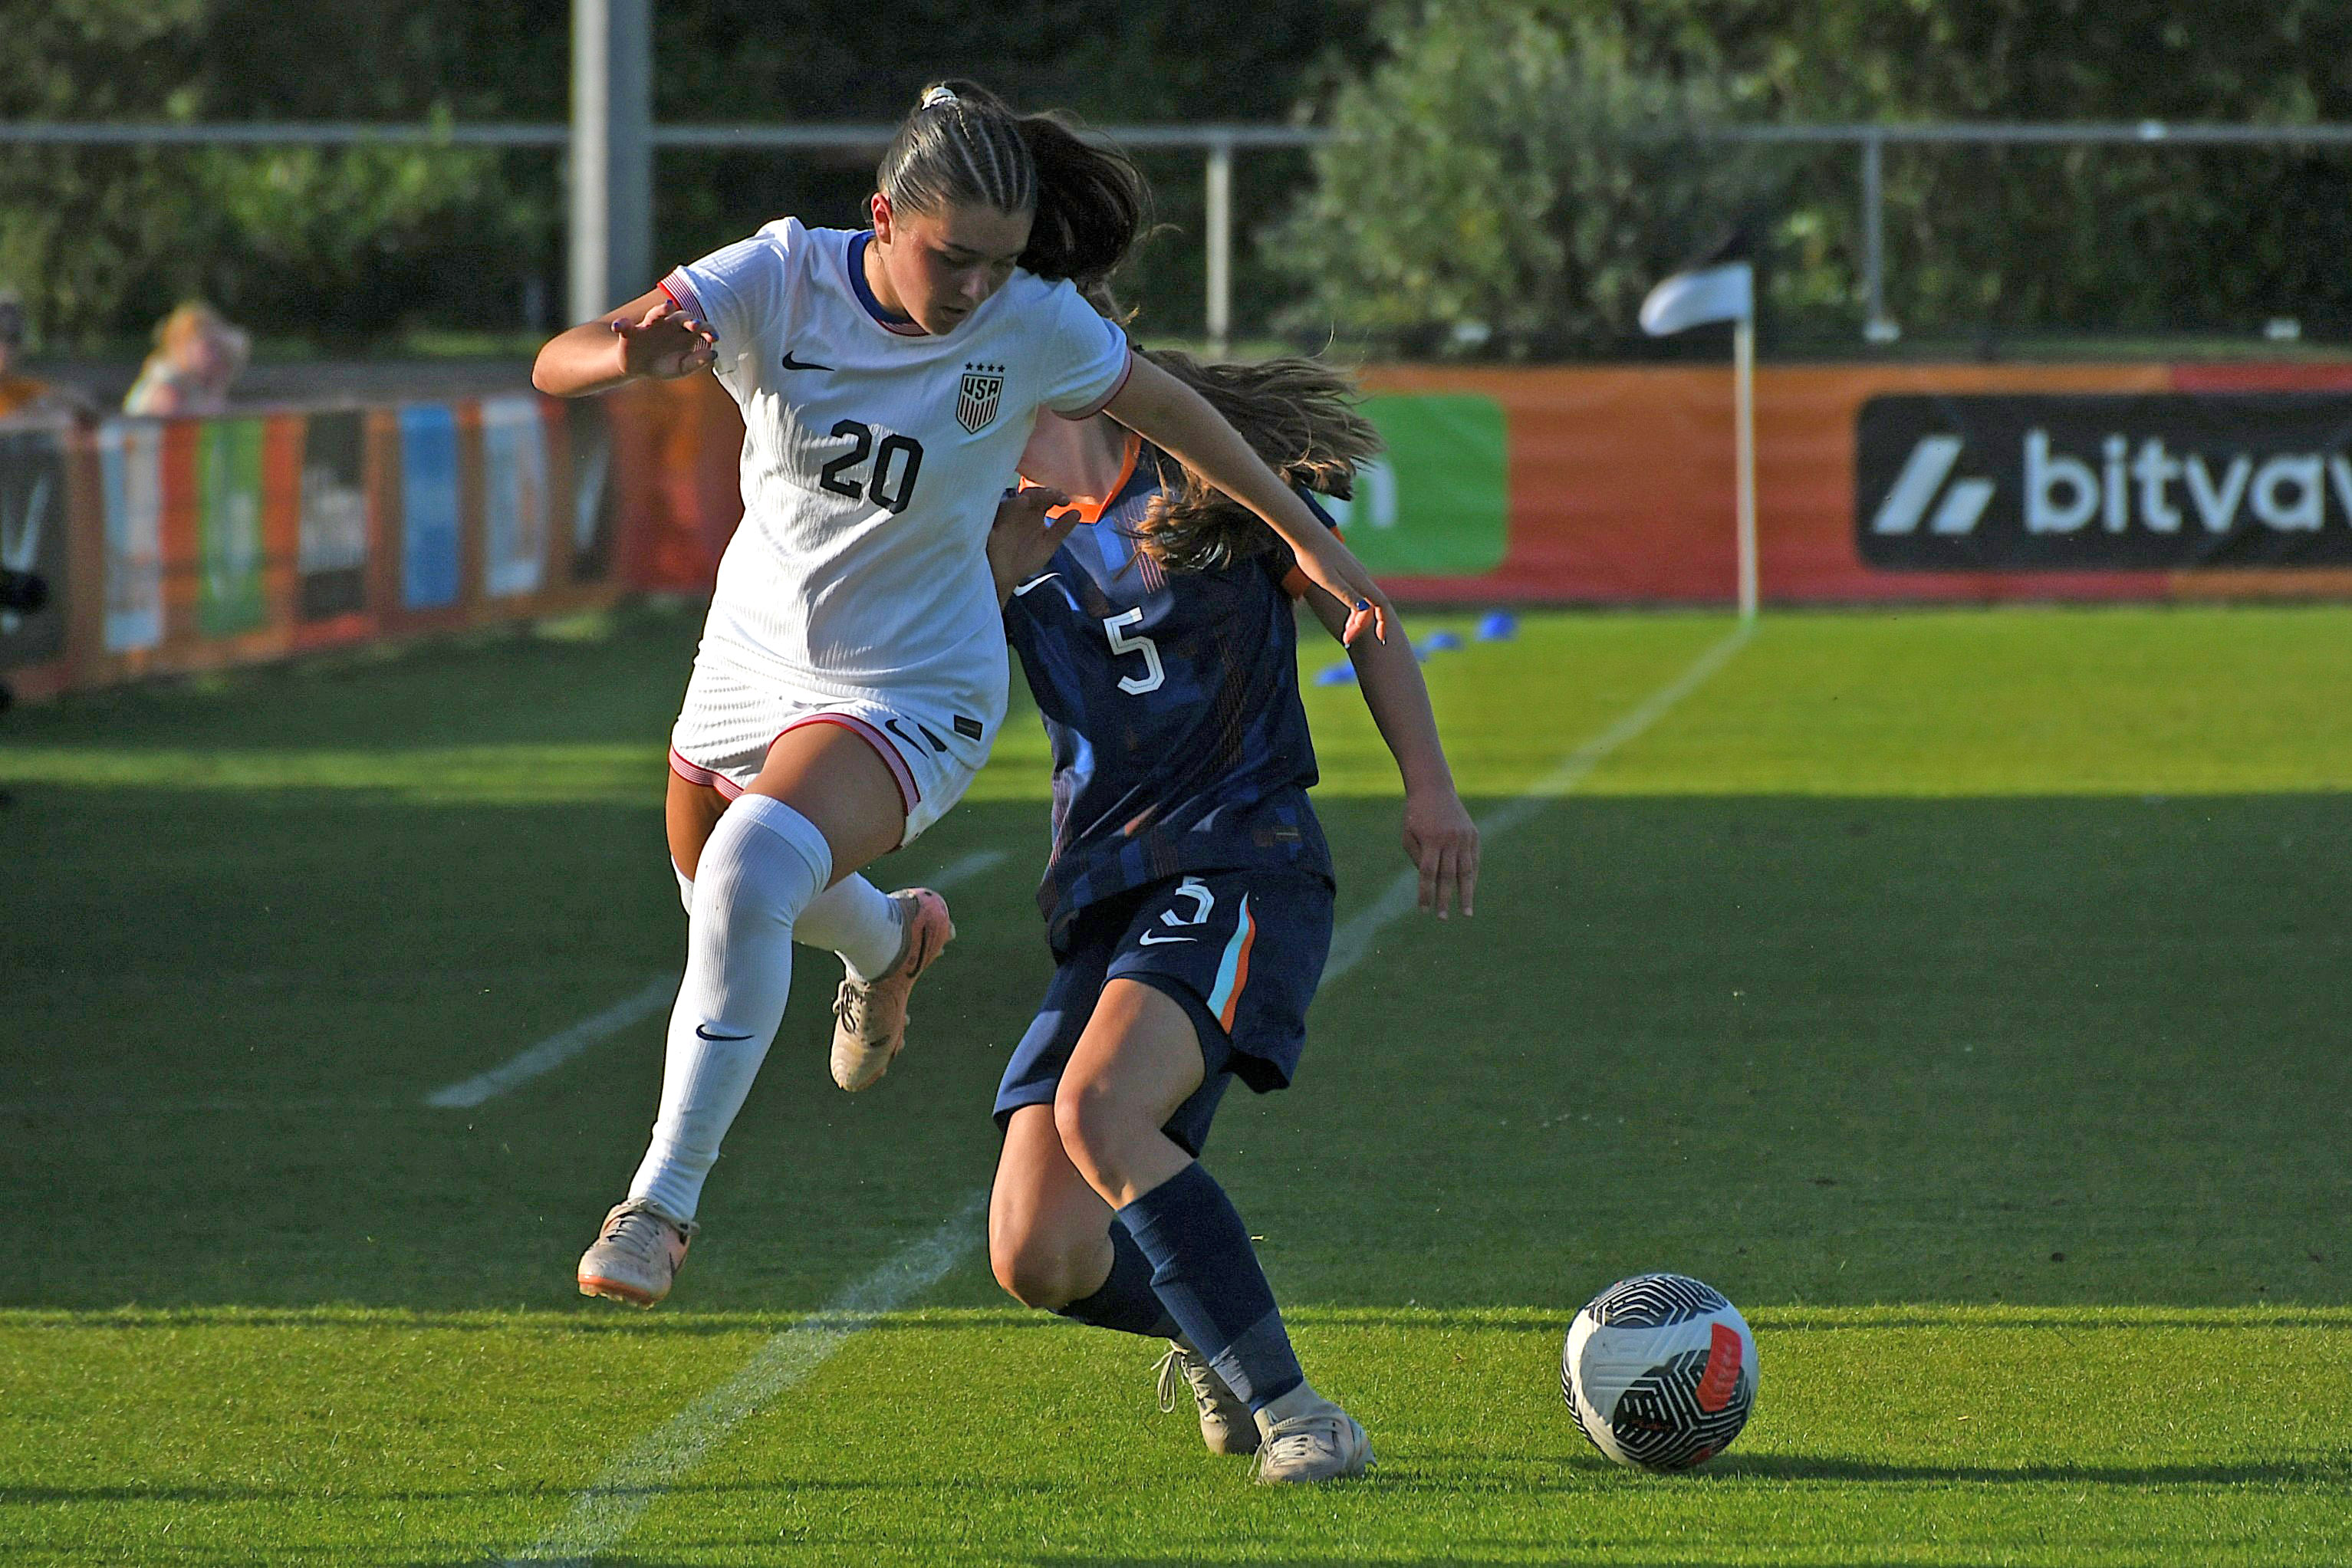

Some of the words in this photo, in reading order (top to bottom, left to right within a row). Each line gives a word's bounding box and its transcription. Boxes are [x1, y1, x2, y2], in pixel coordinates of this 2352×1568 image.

[964, 377, 999, 400] USA
[820, 419, 923, 514] 20
[1103, 607, 1165, 695] 5
[1160, 876, 1214, 926] 5
